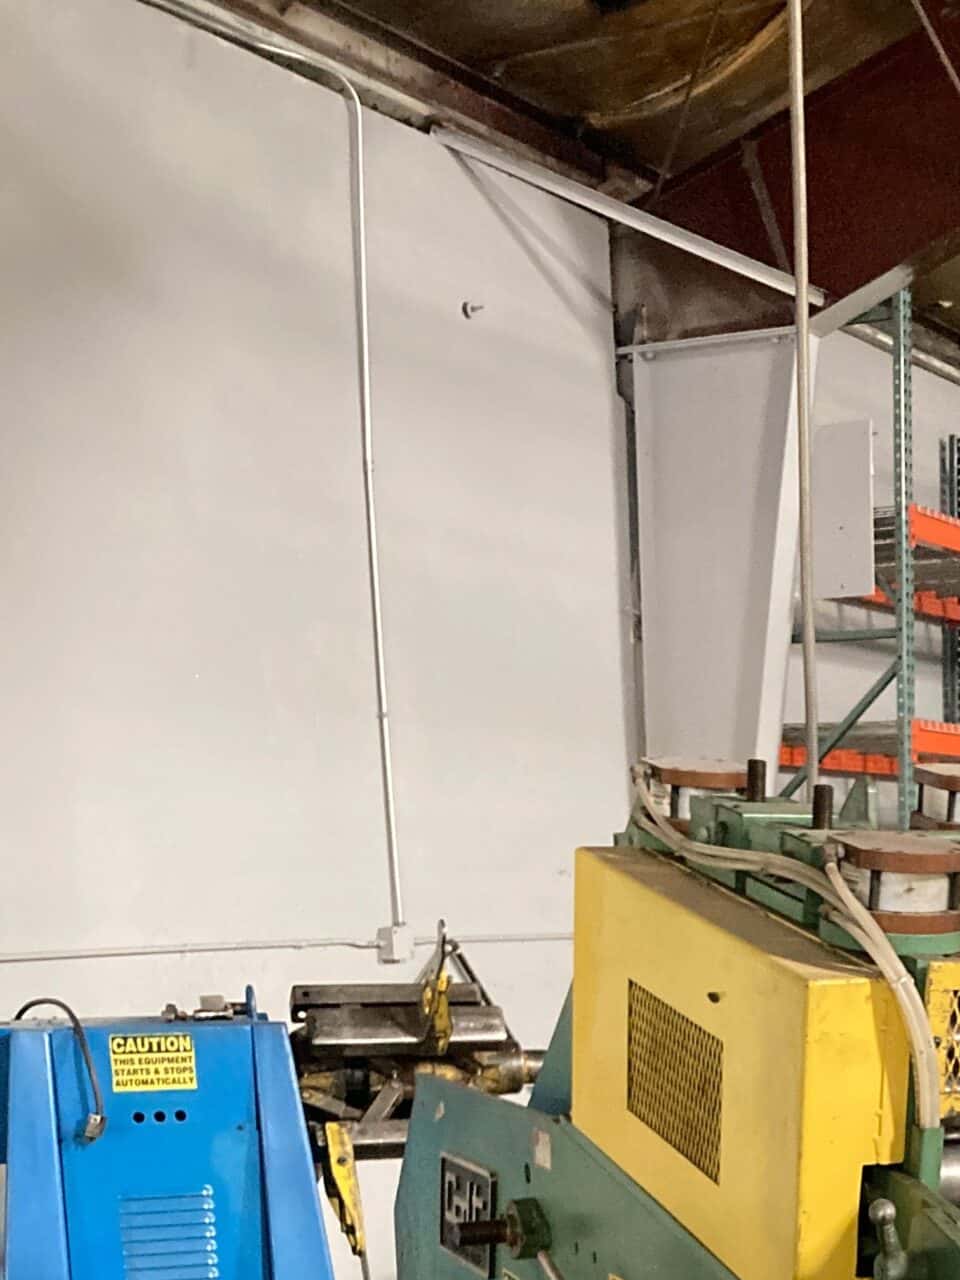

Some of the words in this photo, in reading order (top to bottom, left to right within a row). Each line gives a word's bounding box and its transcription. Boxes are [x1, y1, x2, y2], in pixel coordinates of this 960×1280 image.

[112, 1035, 191, 1053] CAUTION
[113, 1058, 135, 1066] THIS
[139, 1056, 193, 1065] EQUIPMENT
[115, 1068, 150, 1076] STARTS
[154, 1067, 160, 1075] &
[164, 1066, 194, 1075] STOPS
[116, 1077, 194, 1087] AUTOMATICALLY
